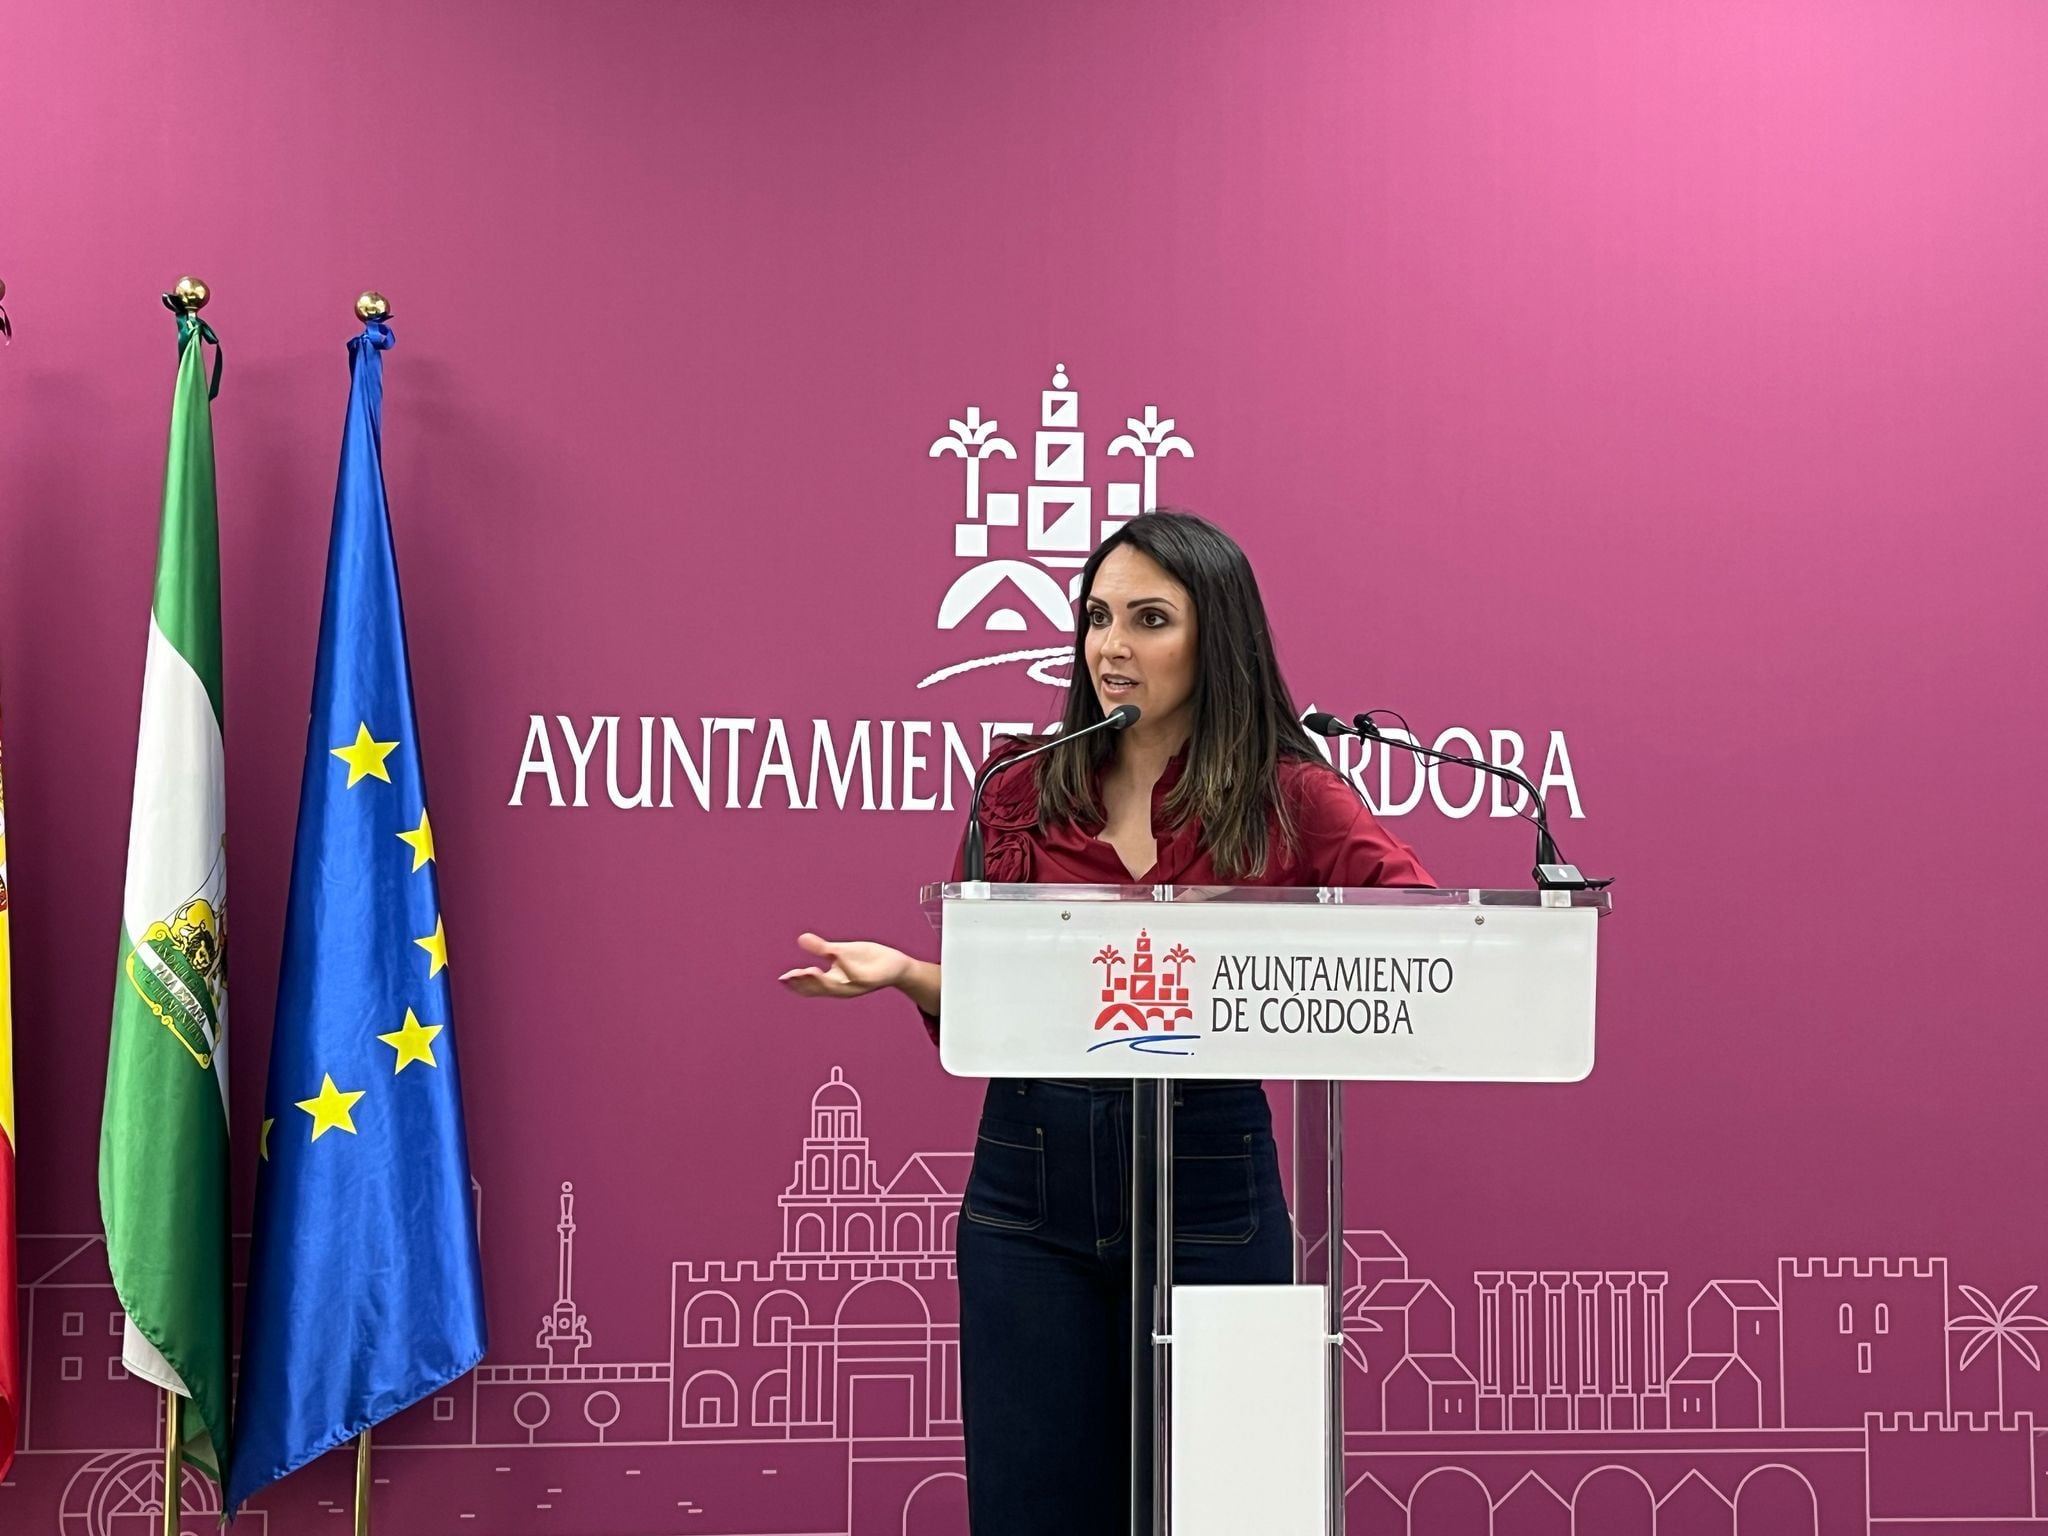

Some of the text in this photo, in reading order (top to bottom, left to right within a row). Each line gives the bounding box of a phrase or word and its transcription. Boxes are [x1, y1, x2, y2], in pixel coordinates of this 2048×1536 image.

[508, 715, 1063, 812] AYUNTAMIEN
[1212, 955, 1453, 993] AYUNTAMIENTO
[1211, 994, 1414, 1034] DE CÓRDOBA
